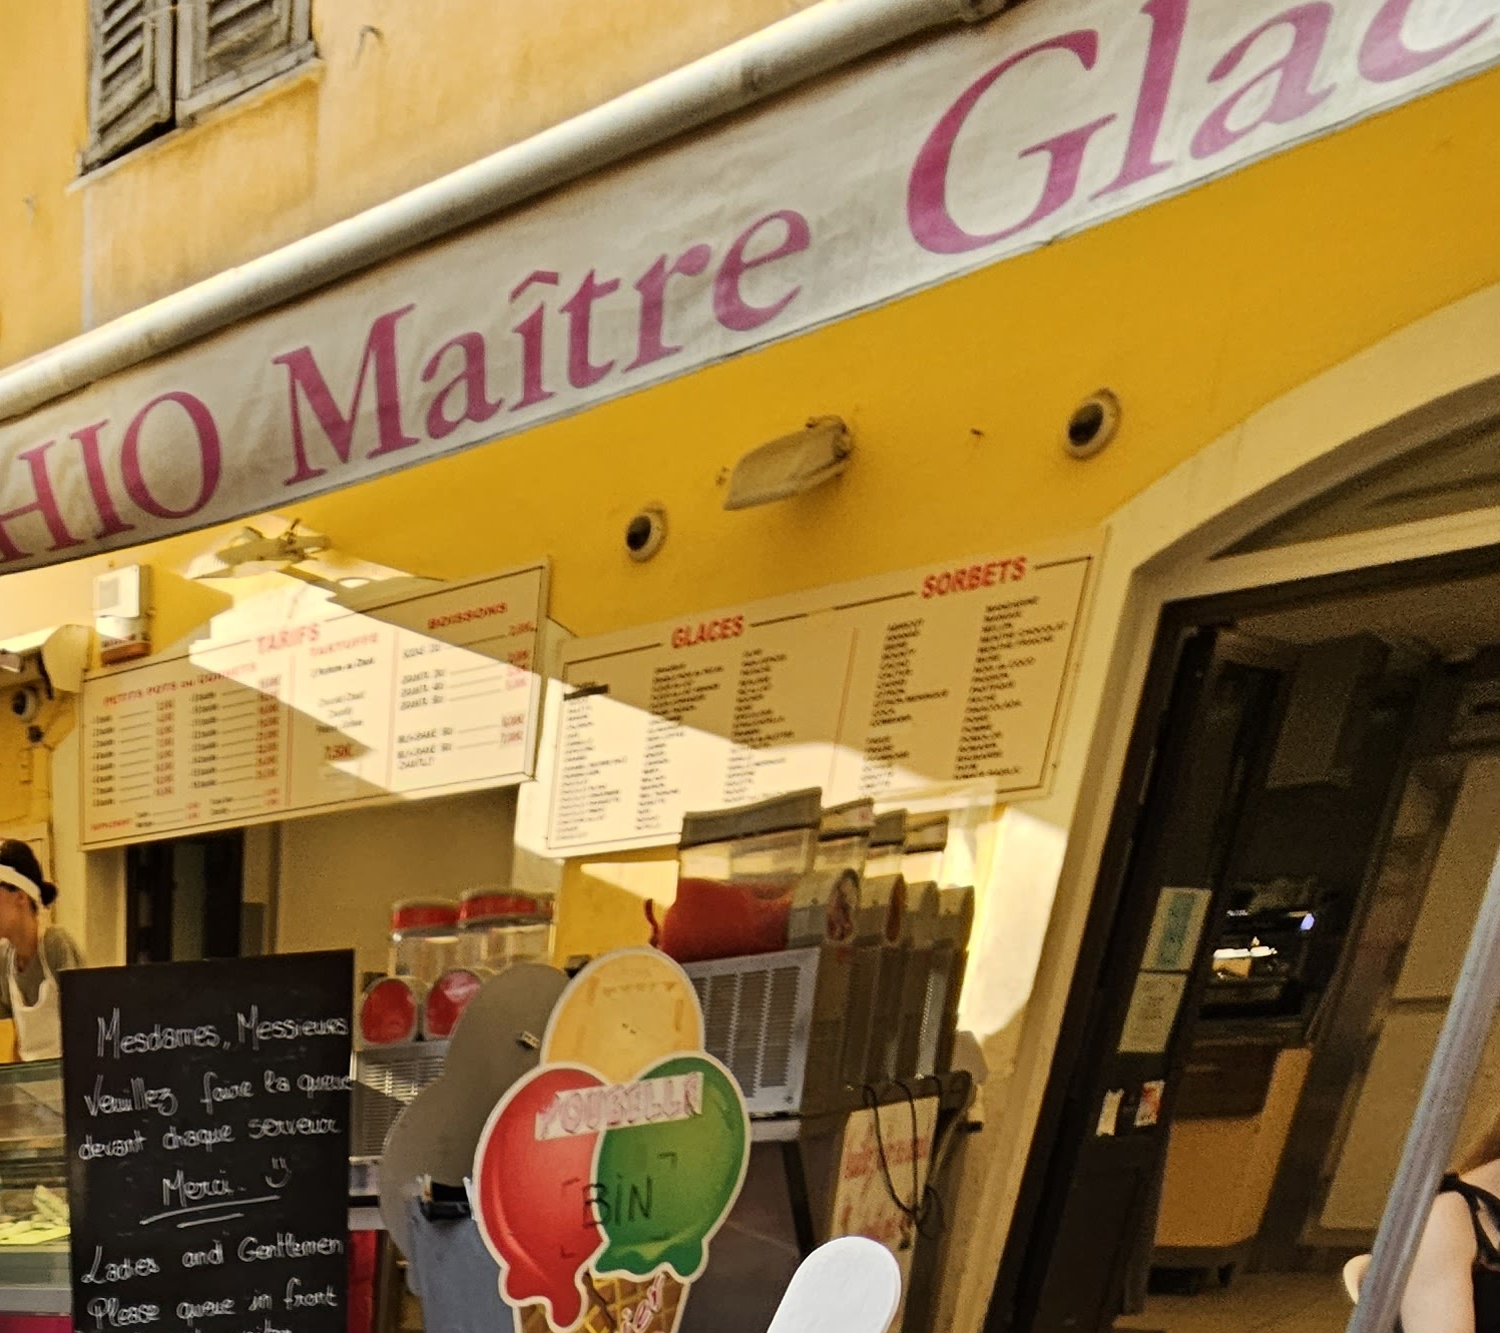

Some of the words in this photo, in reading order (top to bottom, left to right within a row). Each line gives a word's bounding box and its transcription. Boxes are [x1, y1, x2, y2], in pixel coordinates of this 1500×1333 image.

[272, 209, 812, 486] Maître
[920, 556, 1030, 600] SORBETS
[256, 623, 321, 654] TARIFS
[670, 615, 745, 648] GLACES
[201, 1070, 255, 1115] faire
[264, 1069, 291, 1094] la
[79, 1129, 148, 1161] devant
[162, 1122, 236, 1152] chaque
[247, 1116, 341, 1140] serveur
[81, 1245, 160, 1284] Ladies
[182, 1238, 225, 1267] and
[236, 1231, 345, 1262] Gentlemen
[87, 1297, 160, 1330] Please
[176, 1297, 236, 1327] queue
[248, 1290, 273, 1312] in
[283, 1276, 339, 1308] front
